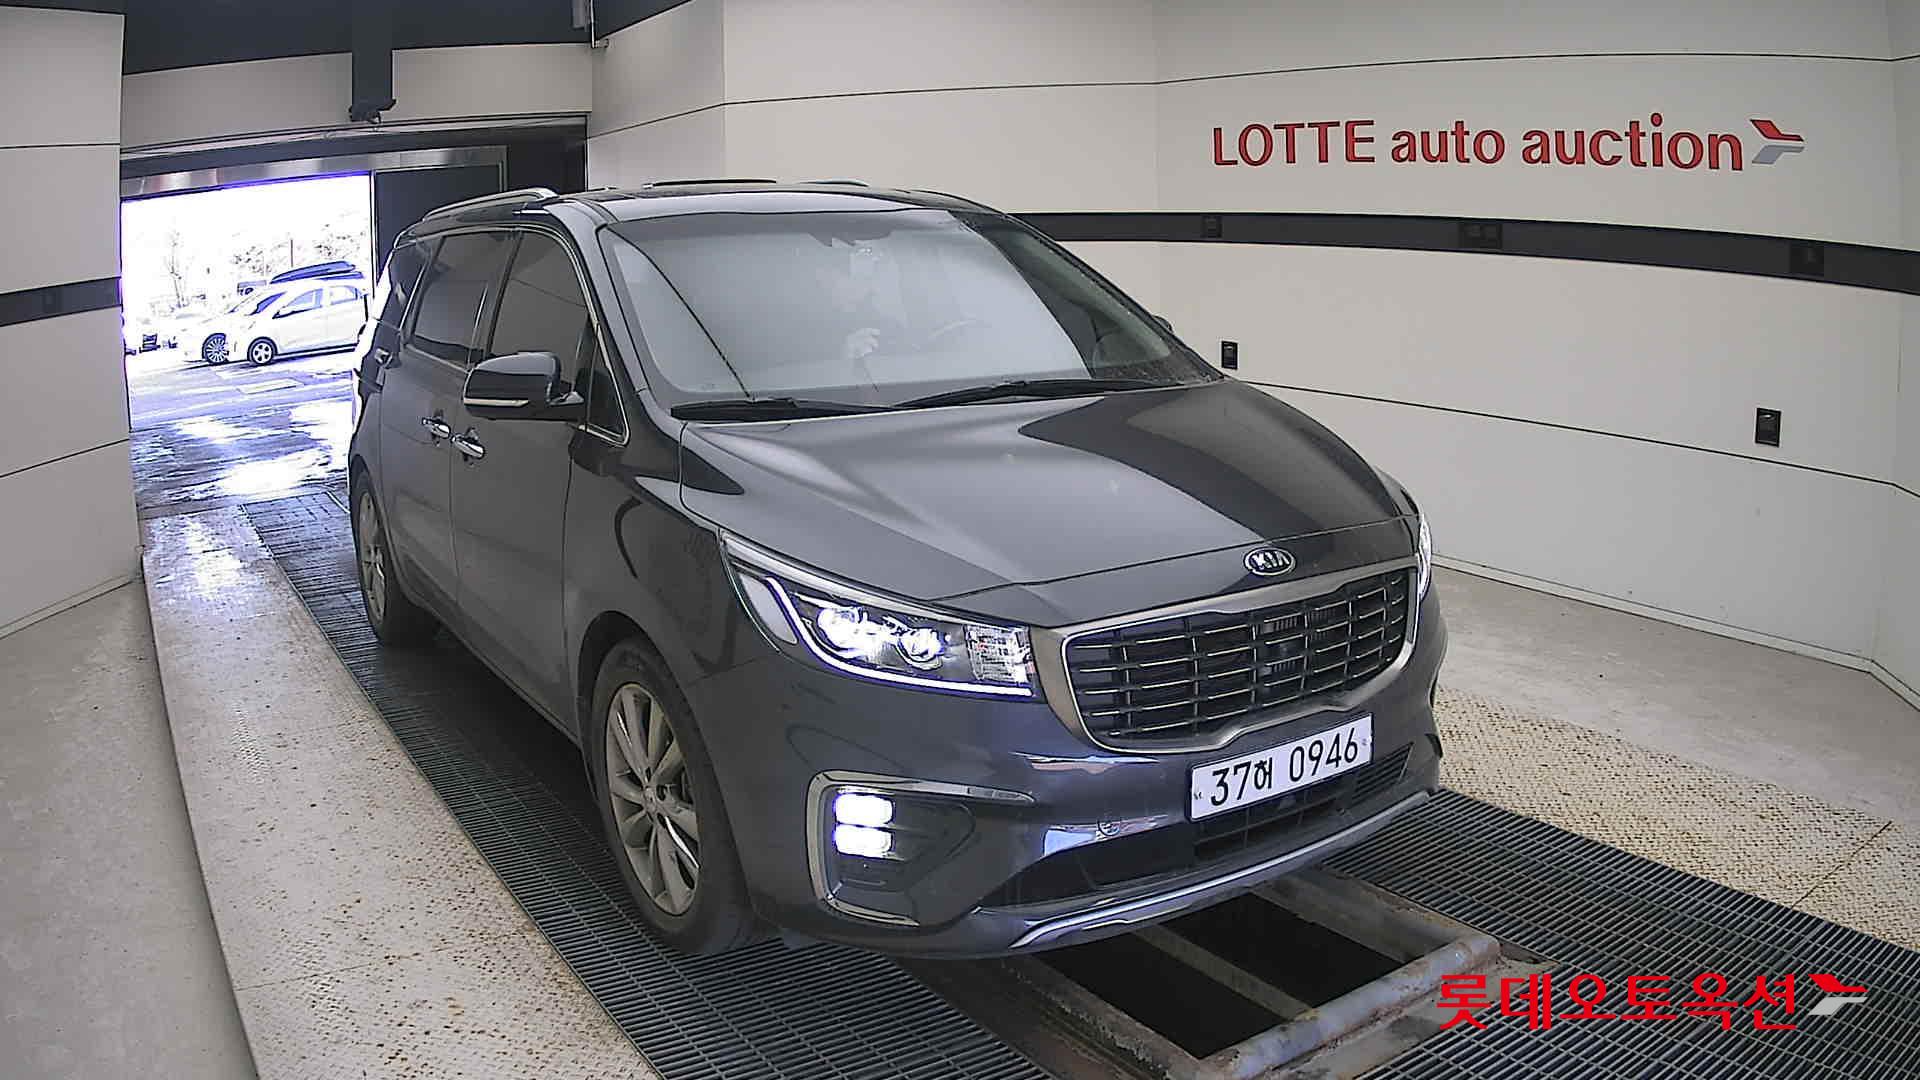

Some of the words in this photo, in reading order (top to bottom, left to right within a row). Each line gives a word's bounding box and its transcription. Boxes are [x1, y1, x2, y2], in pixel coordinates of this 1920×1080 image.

[1212, 119, 1375, 166] LOTTE
[1390, 119, 1506, 166] auto
[1520, 112, 1744, 172] auction
[1250, 550, 1291, 570] KIA
[1210, 756, 1274, 806] 37허
[1288, 727, 1359, 783] 0946
